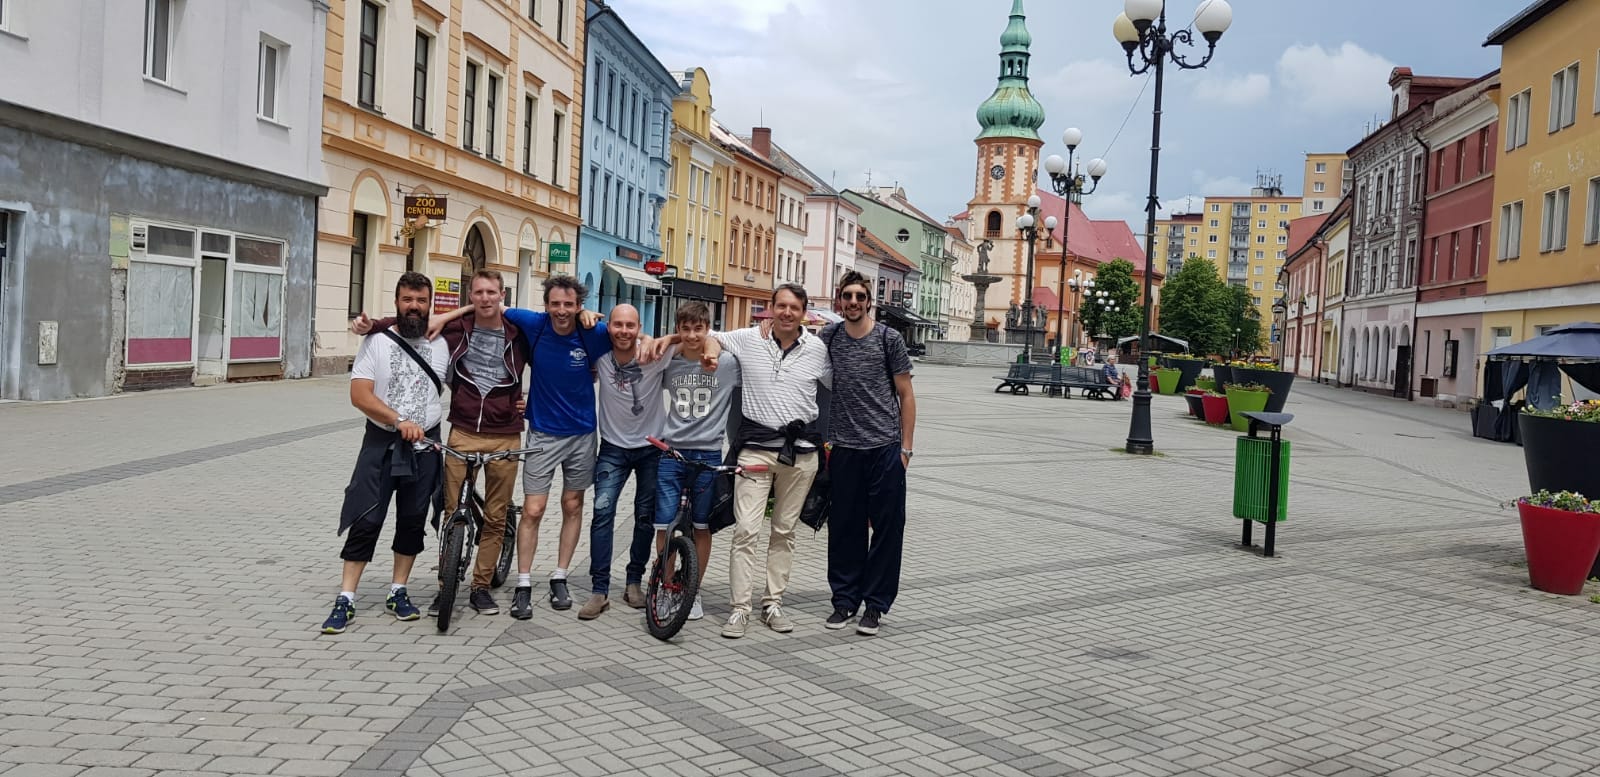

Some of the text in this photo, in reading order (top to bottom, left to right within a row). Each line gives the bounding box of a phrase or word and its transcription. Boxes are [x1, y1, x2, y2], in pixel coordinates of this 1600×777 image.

[416, 198, 436, 207] ZOO
[407, 206, 444, 216] CENTRUM
[676, 388, 711, 418] 88
